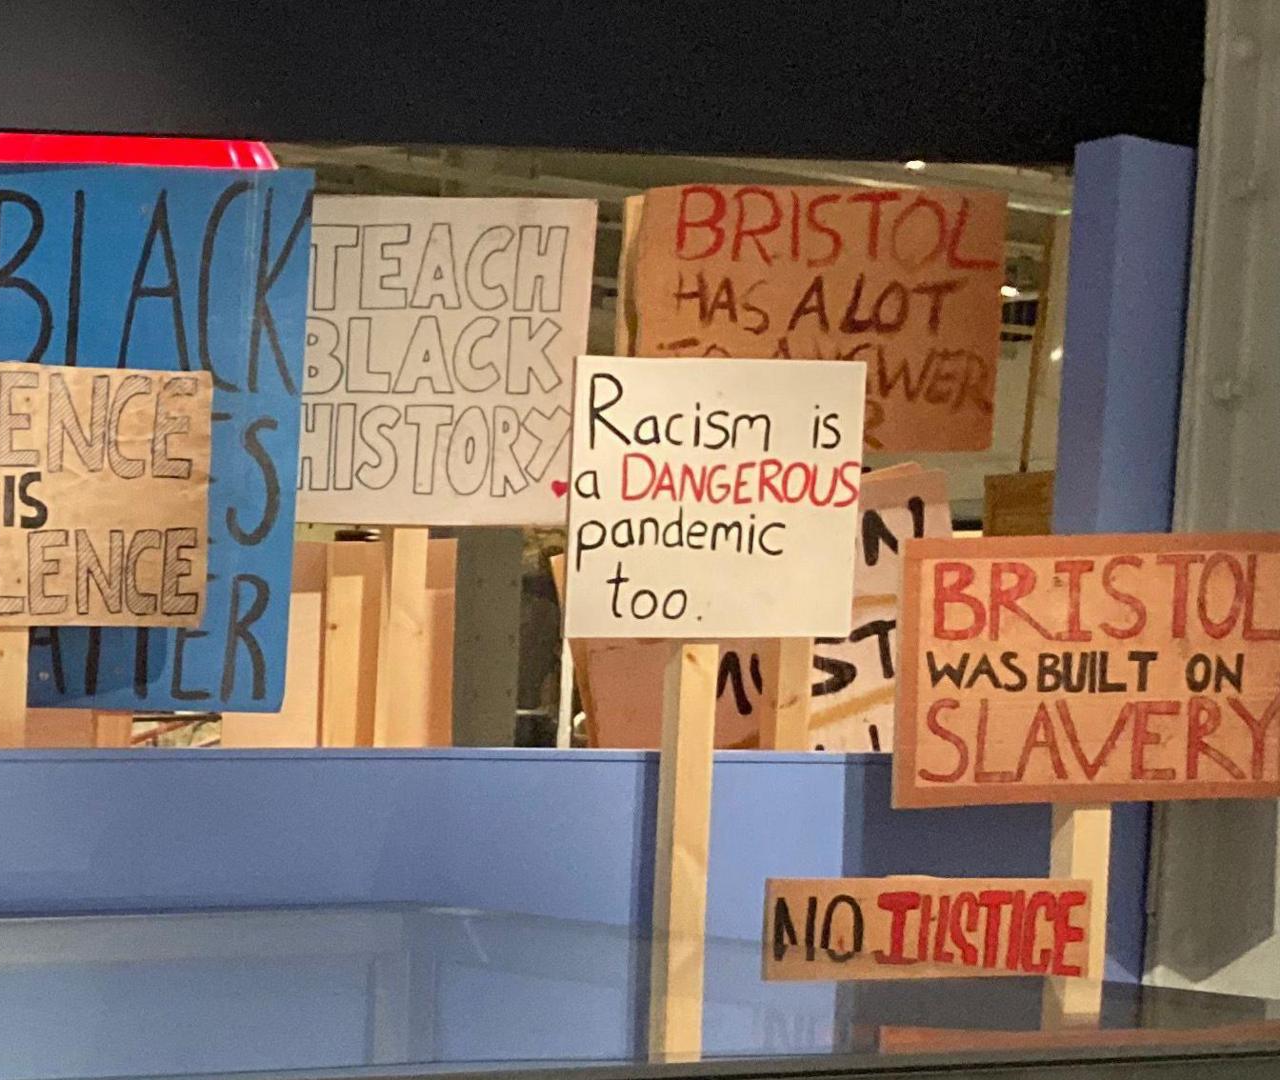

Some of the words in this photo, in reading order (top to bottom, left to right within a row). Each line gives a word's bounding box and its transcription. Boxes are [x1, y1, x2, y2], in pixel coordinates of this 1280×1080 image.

[673, 185, 1000, 271] BRISTOL
[310, 222, 570, 313] TEACH
[672, 271, 770, 335] HAS
[301, 315, 563, 395] BLACK
[589, 372, 771, 452] Racism
[811, 404, 842, 450] is
[296, 402, 572, 498] HISTORY
[574, 469, 600, 500] a
[621, 452, 861, 508] DANGEROUS
[2, 471, 49, 529] IS
[576, 505, 786, 572] pandemic
[606, 561, 703, 621] too.
[932, 551, 1280, 643] BRISTOL
[926, 650, 1028, 693] WAS
[1037, 650, 1159, 694] BUILT
[1185, 652, 1245, 694] ON
[918, 695, 1280, 784] SLAVERY
[772, 894, 864, 963] NO
